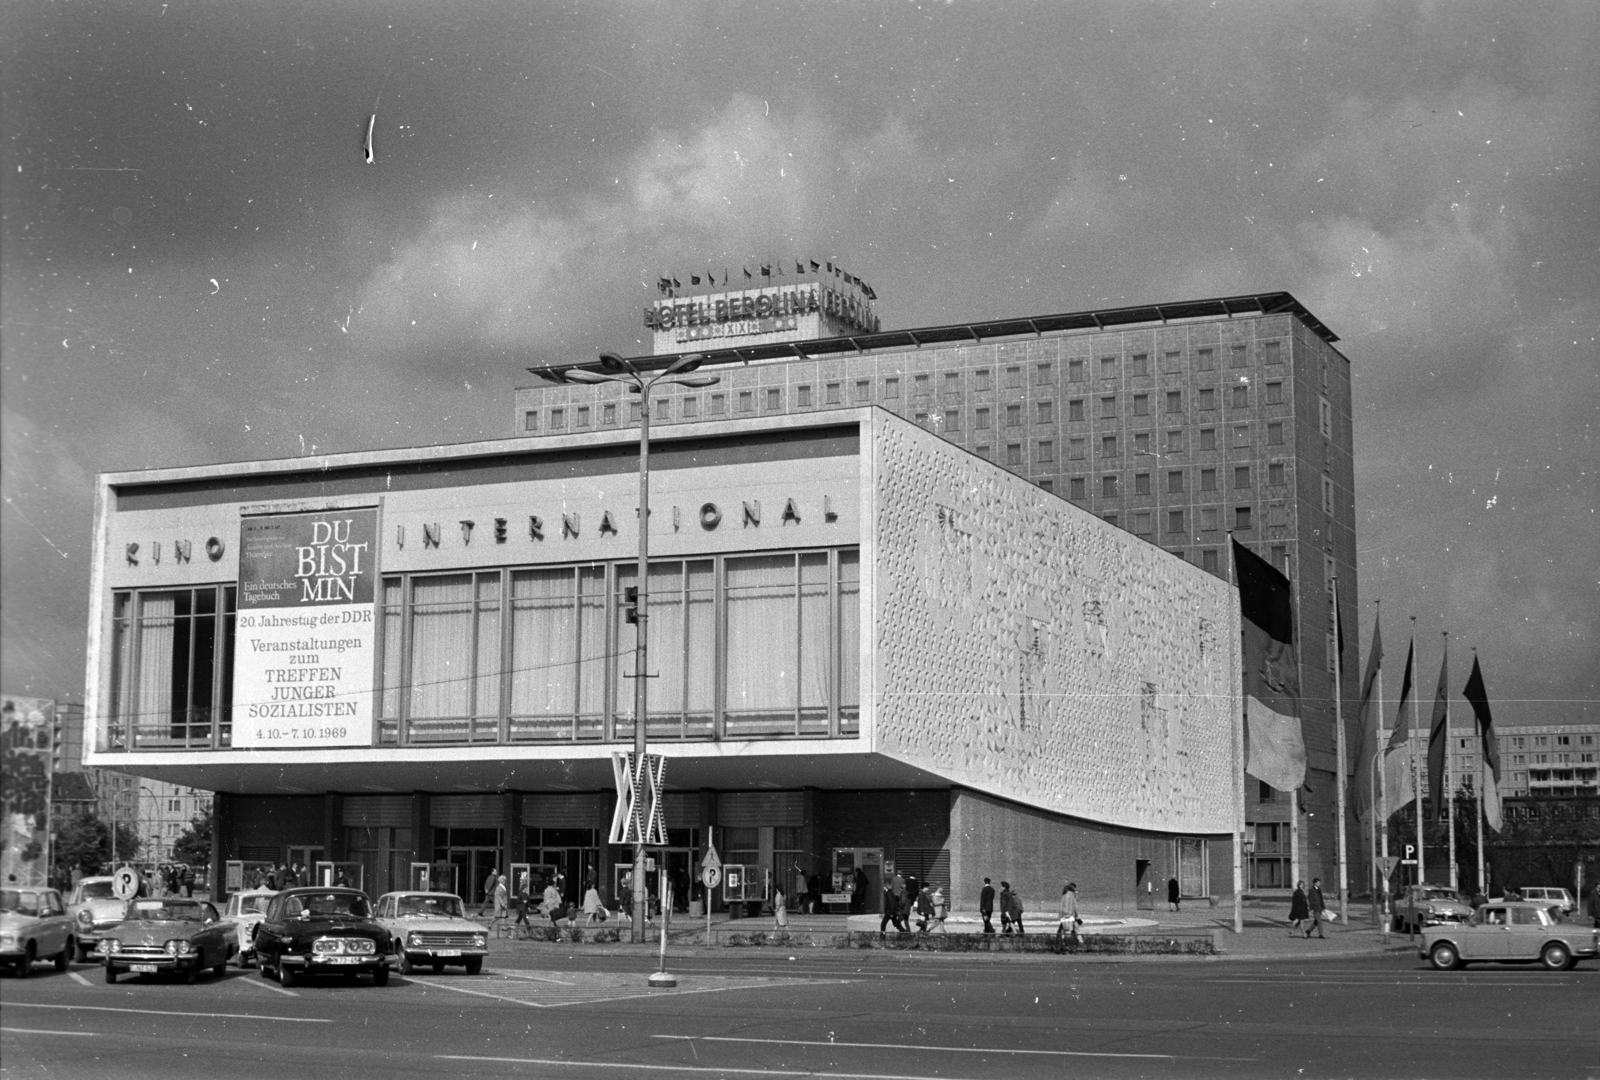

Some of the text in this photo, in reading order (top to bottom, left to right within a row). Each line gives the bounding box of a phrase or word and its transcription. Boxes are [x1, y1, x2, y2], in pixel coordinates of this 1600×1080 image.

[643, 289, 819, 330] HOTEL BEROLINA
[310, 520, 354, 546] DU
[125, 536, 226, 566] KINO
[294, 541, 369, 577] BIST
[243, 579, 297, 591] Ein deutsches
[300, 576, 357, 602] MIN
[243, 590, 280, 603] Tagebuch
[240, 610, 372, 629] 20. Jahrestag der DDR
[250, 637, 362, 653] Veranstaltungen
[289, 654, 320, 665] zum
[265, 667, 342, 683] TREFFEN
[271, 685, 336, 700] JUNGER
[248, 702, 358, 718] SOZIALISTEN
[1405, 844, 1415, 860] P
[122, 873, 131, 894] P
[709, 868, 716, 884] P
